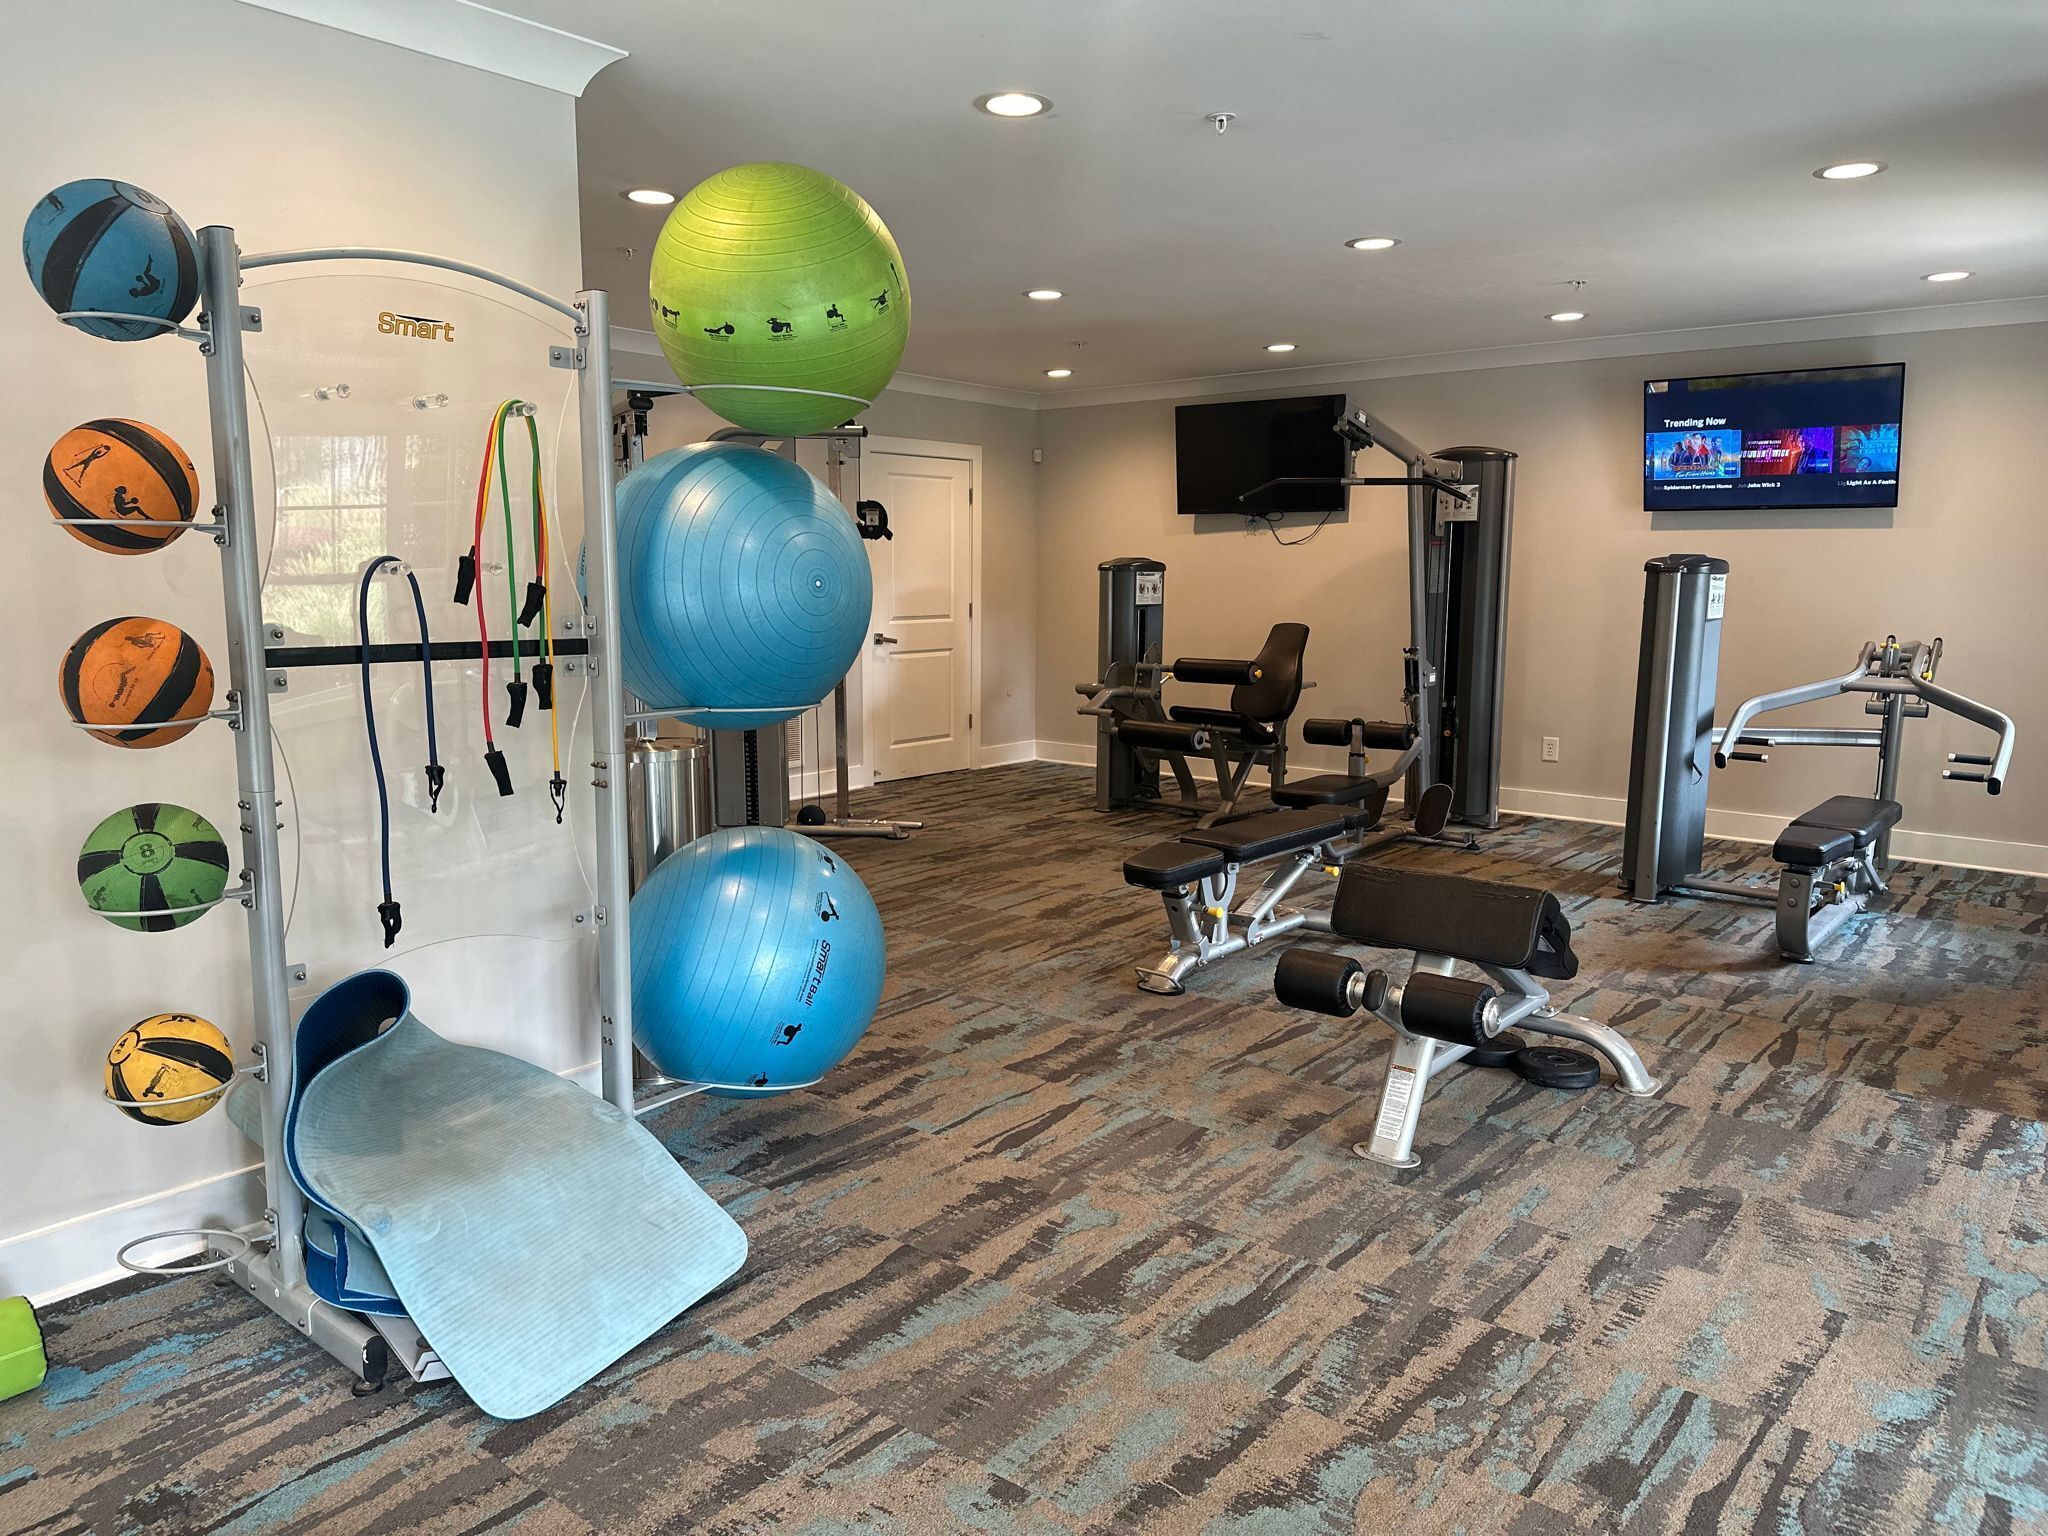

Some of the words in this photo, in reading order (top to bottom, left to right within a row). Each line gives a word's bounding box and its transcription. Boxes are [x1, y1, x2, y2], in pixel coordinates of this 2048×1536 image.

[378, 311, 455, 342] Smart
[1664, 419, 1704, 427] Trending
[1706, 417, 1727, 425] Now
